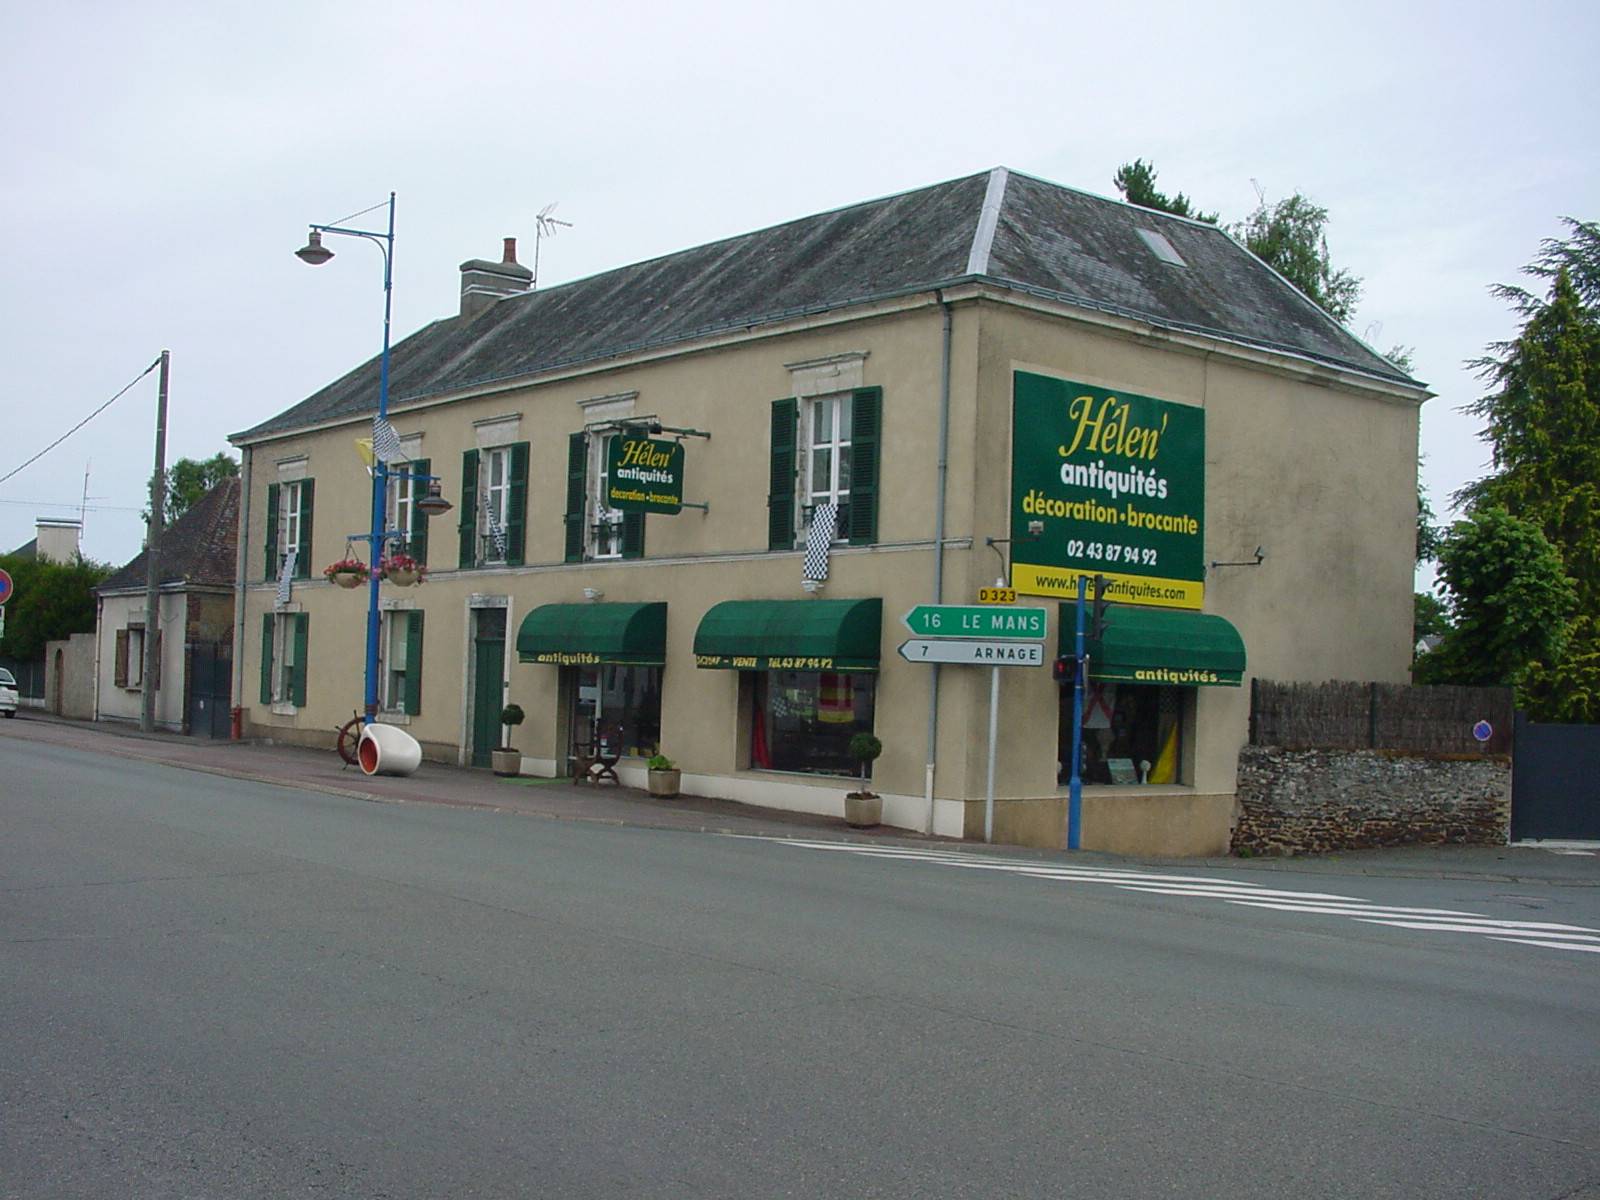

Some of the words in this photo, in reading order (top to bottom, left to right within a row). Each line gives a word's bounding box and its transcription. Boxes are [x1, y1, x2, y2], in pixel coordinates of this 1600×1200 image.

[617, 467, 673, 484] antiquités
[1060, 460, 1168, 499] antiquités
[1127, 504, 1198, 535] brocante
[1067, 540, 1084, 558] 02
[1086, 542, 1103, 560] 43
[1105, 544, 1122, 562] 87
[1124, 546, 1139, 564] 94
[1141, 548, 1157, 566] 92
[980, 590, 988, 601] D
[991, 590, 1016, 601] 323
[923, 613, 942, 628] 16
[962, 614, 981, 629] LE
[991, 615, 1039, 631] MANS
[537, 652, 600, 666] antiquités
[921, 646, 929, 657] 7
[974, 647, 1037, 660] ARNAGE
[732, 657, 758, 668] VENTE
[1135, 668, 1218, 684] antiquités
